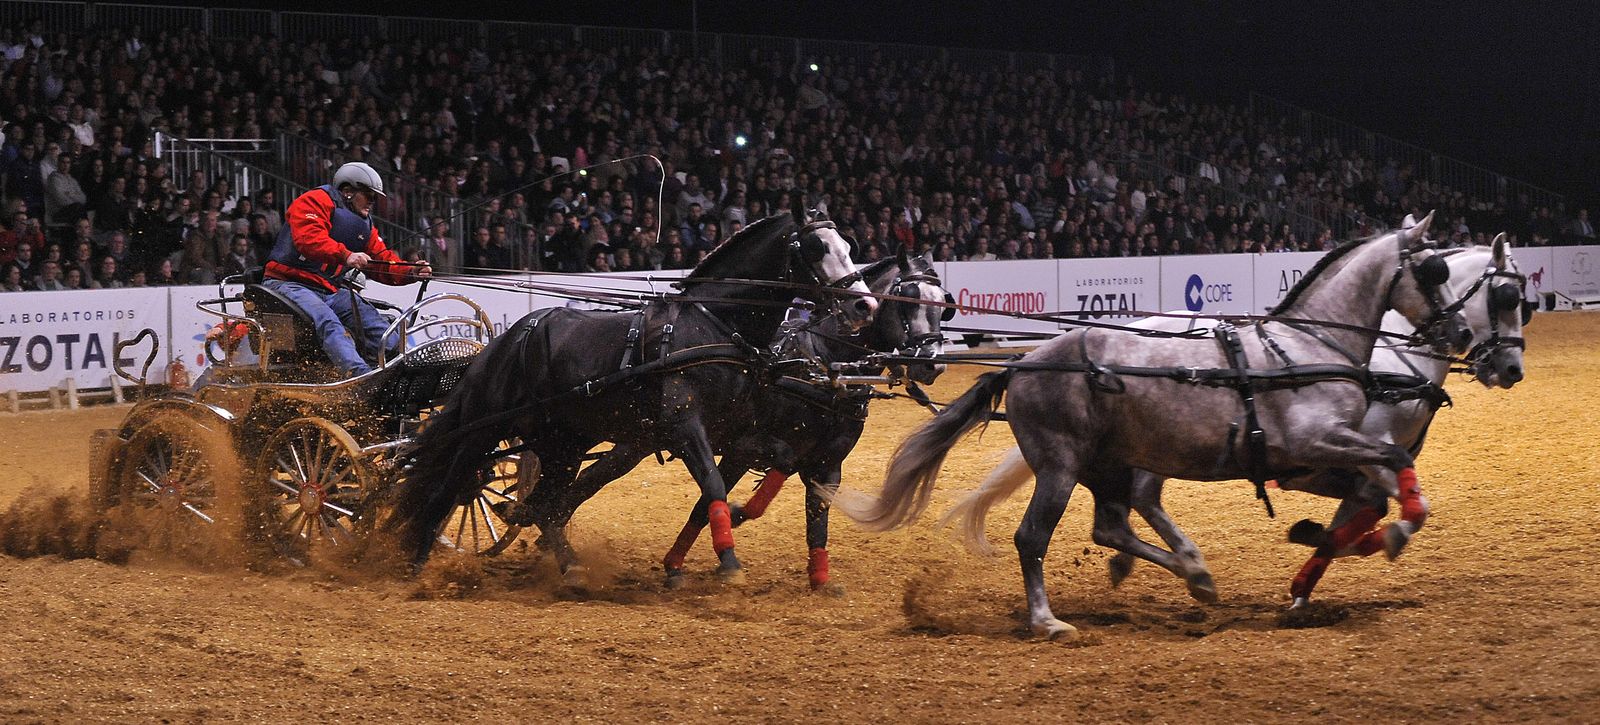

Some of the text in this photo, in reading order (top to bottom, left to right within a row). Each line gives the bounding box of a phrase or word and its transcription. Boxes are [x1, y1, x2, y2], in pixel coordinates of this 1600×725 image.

[1076, 277, 1143, 287] LABORATORIOS
[1205, 284, 1232, 302] COPE
[958, 287, 1045, 316] Cruzcampo
[1077, 293, 1143, 320] ZOTAL
[0, 332, 135, 373] ZOTAL
